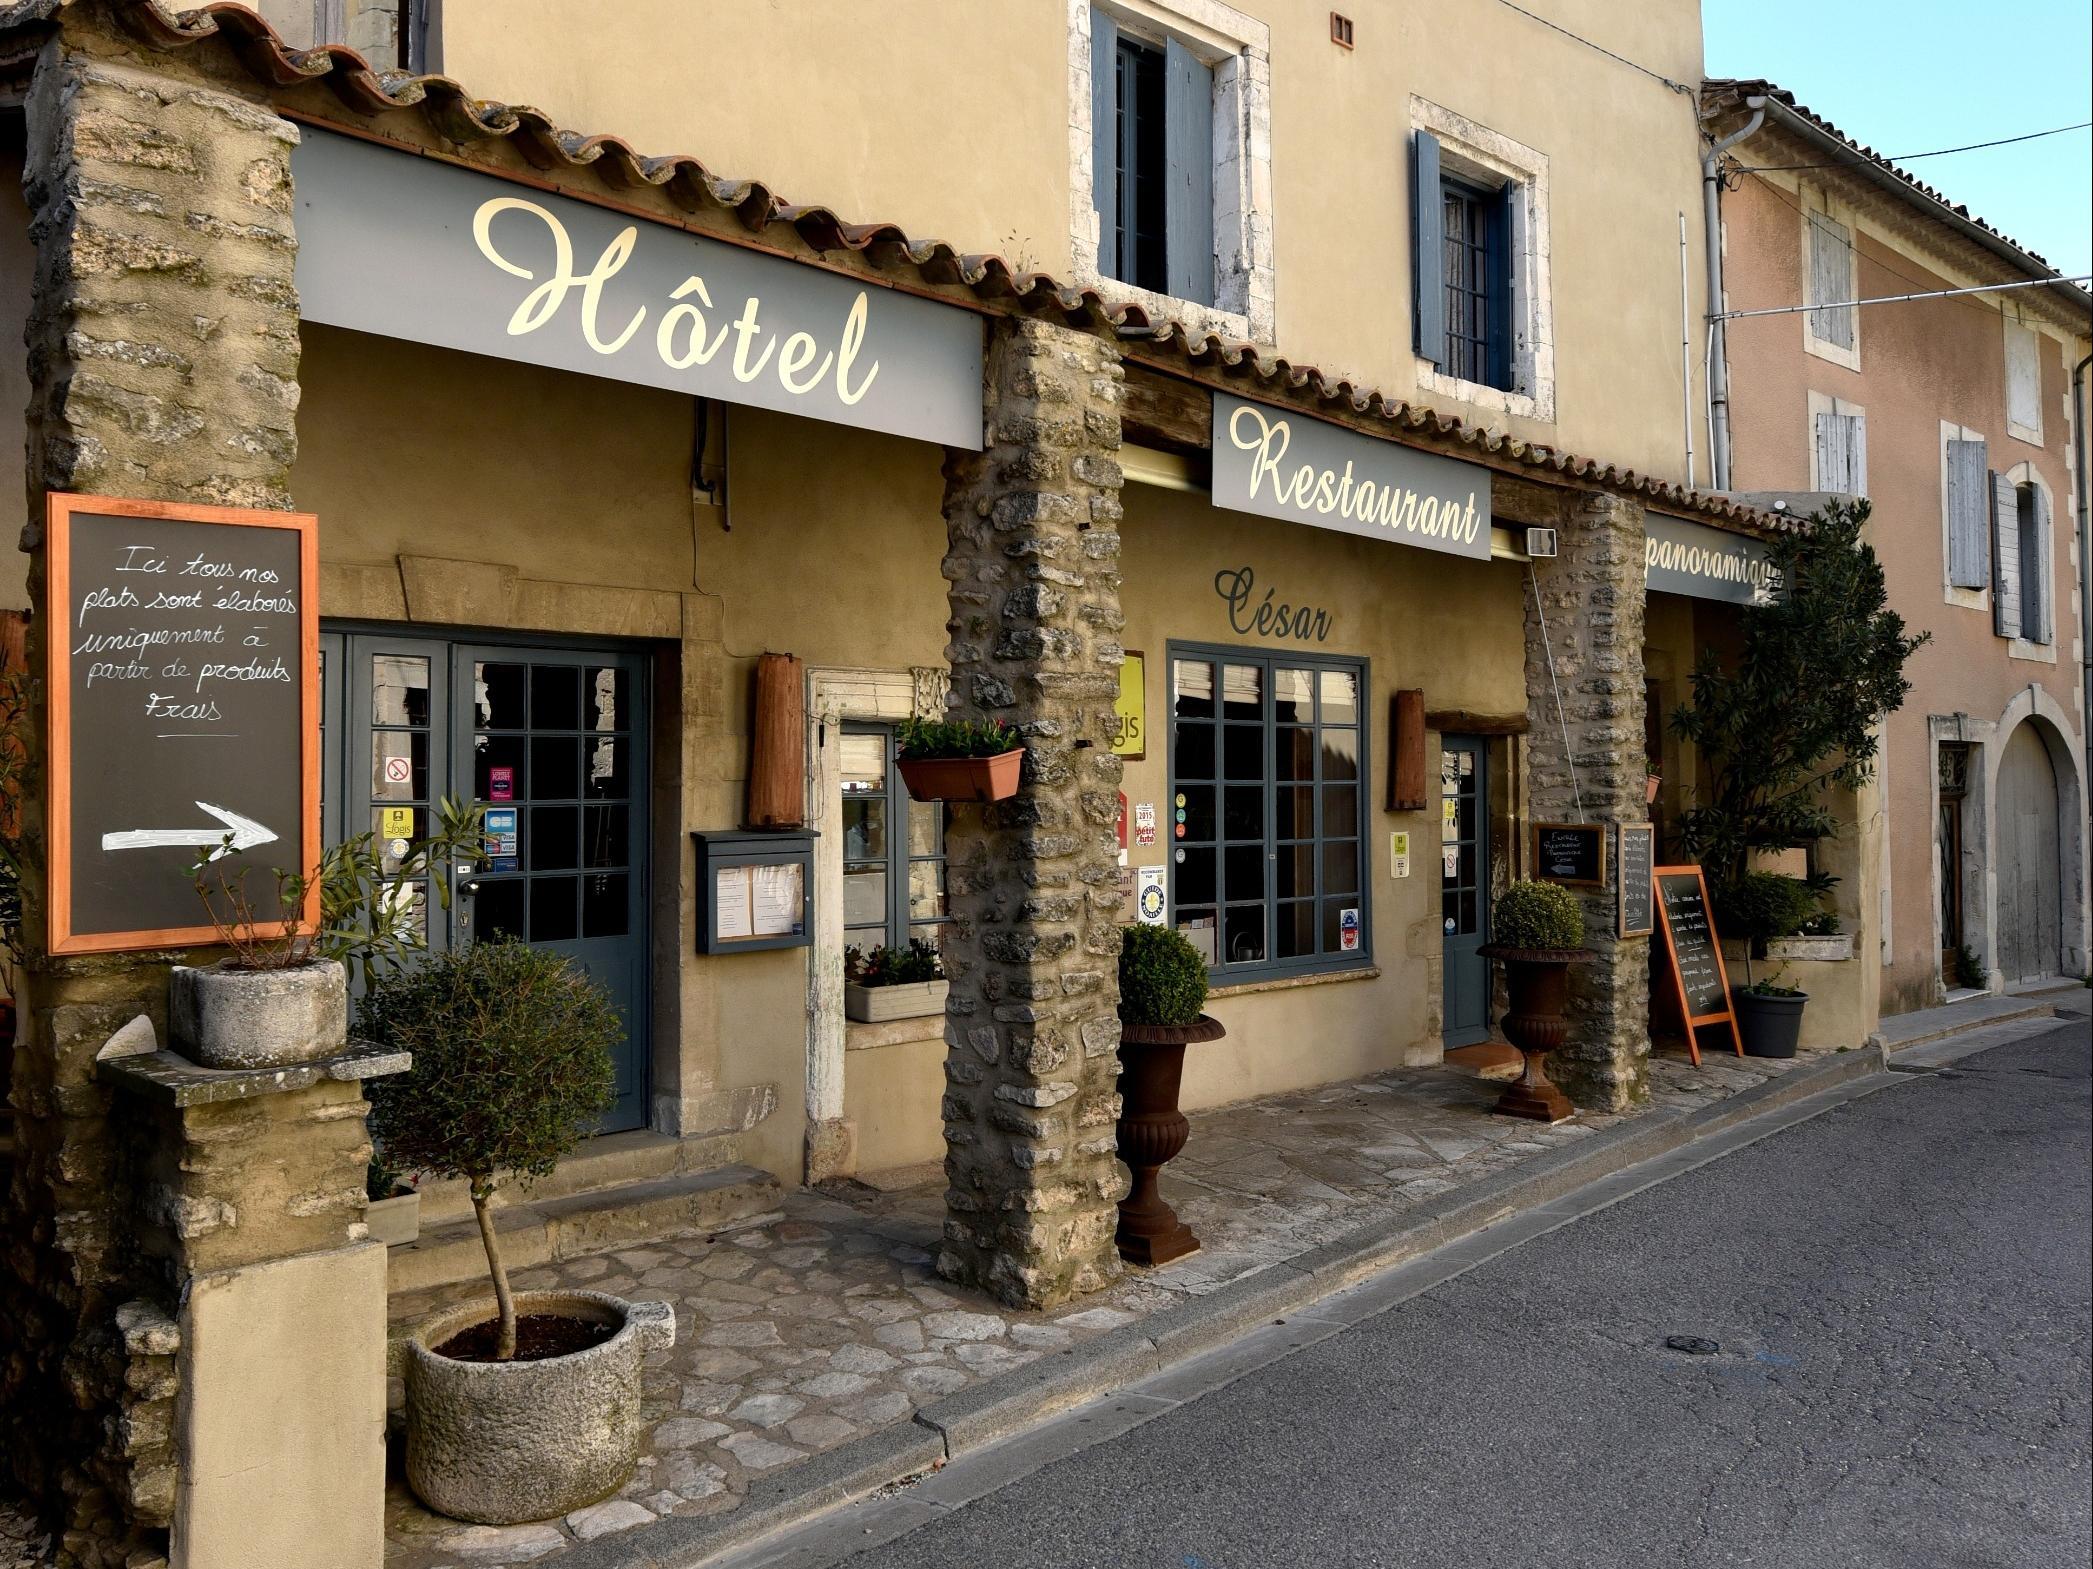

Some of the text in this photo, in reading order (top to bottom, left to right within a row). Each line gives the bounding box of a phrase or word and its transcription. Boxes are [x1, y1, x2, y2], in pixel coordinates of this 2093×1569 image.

[473, 197, 878, 405] Hôtel
[1230, 406, 1480, 544] Restaurant
[115, 546, 279, 583] Ici tous nos
[79, 585, 297, 628] plats sont élaborés
[1214, 567, 1332, 641] César
[72, 625, 225, 660] uniquement
[87, 657, 291, 693] partir de produits
[146, 693, 222, 720] Frais
[1112, 712, 1139, 747] gis
[1139, 812, 1152, 820] 2015
